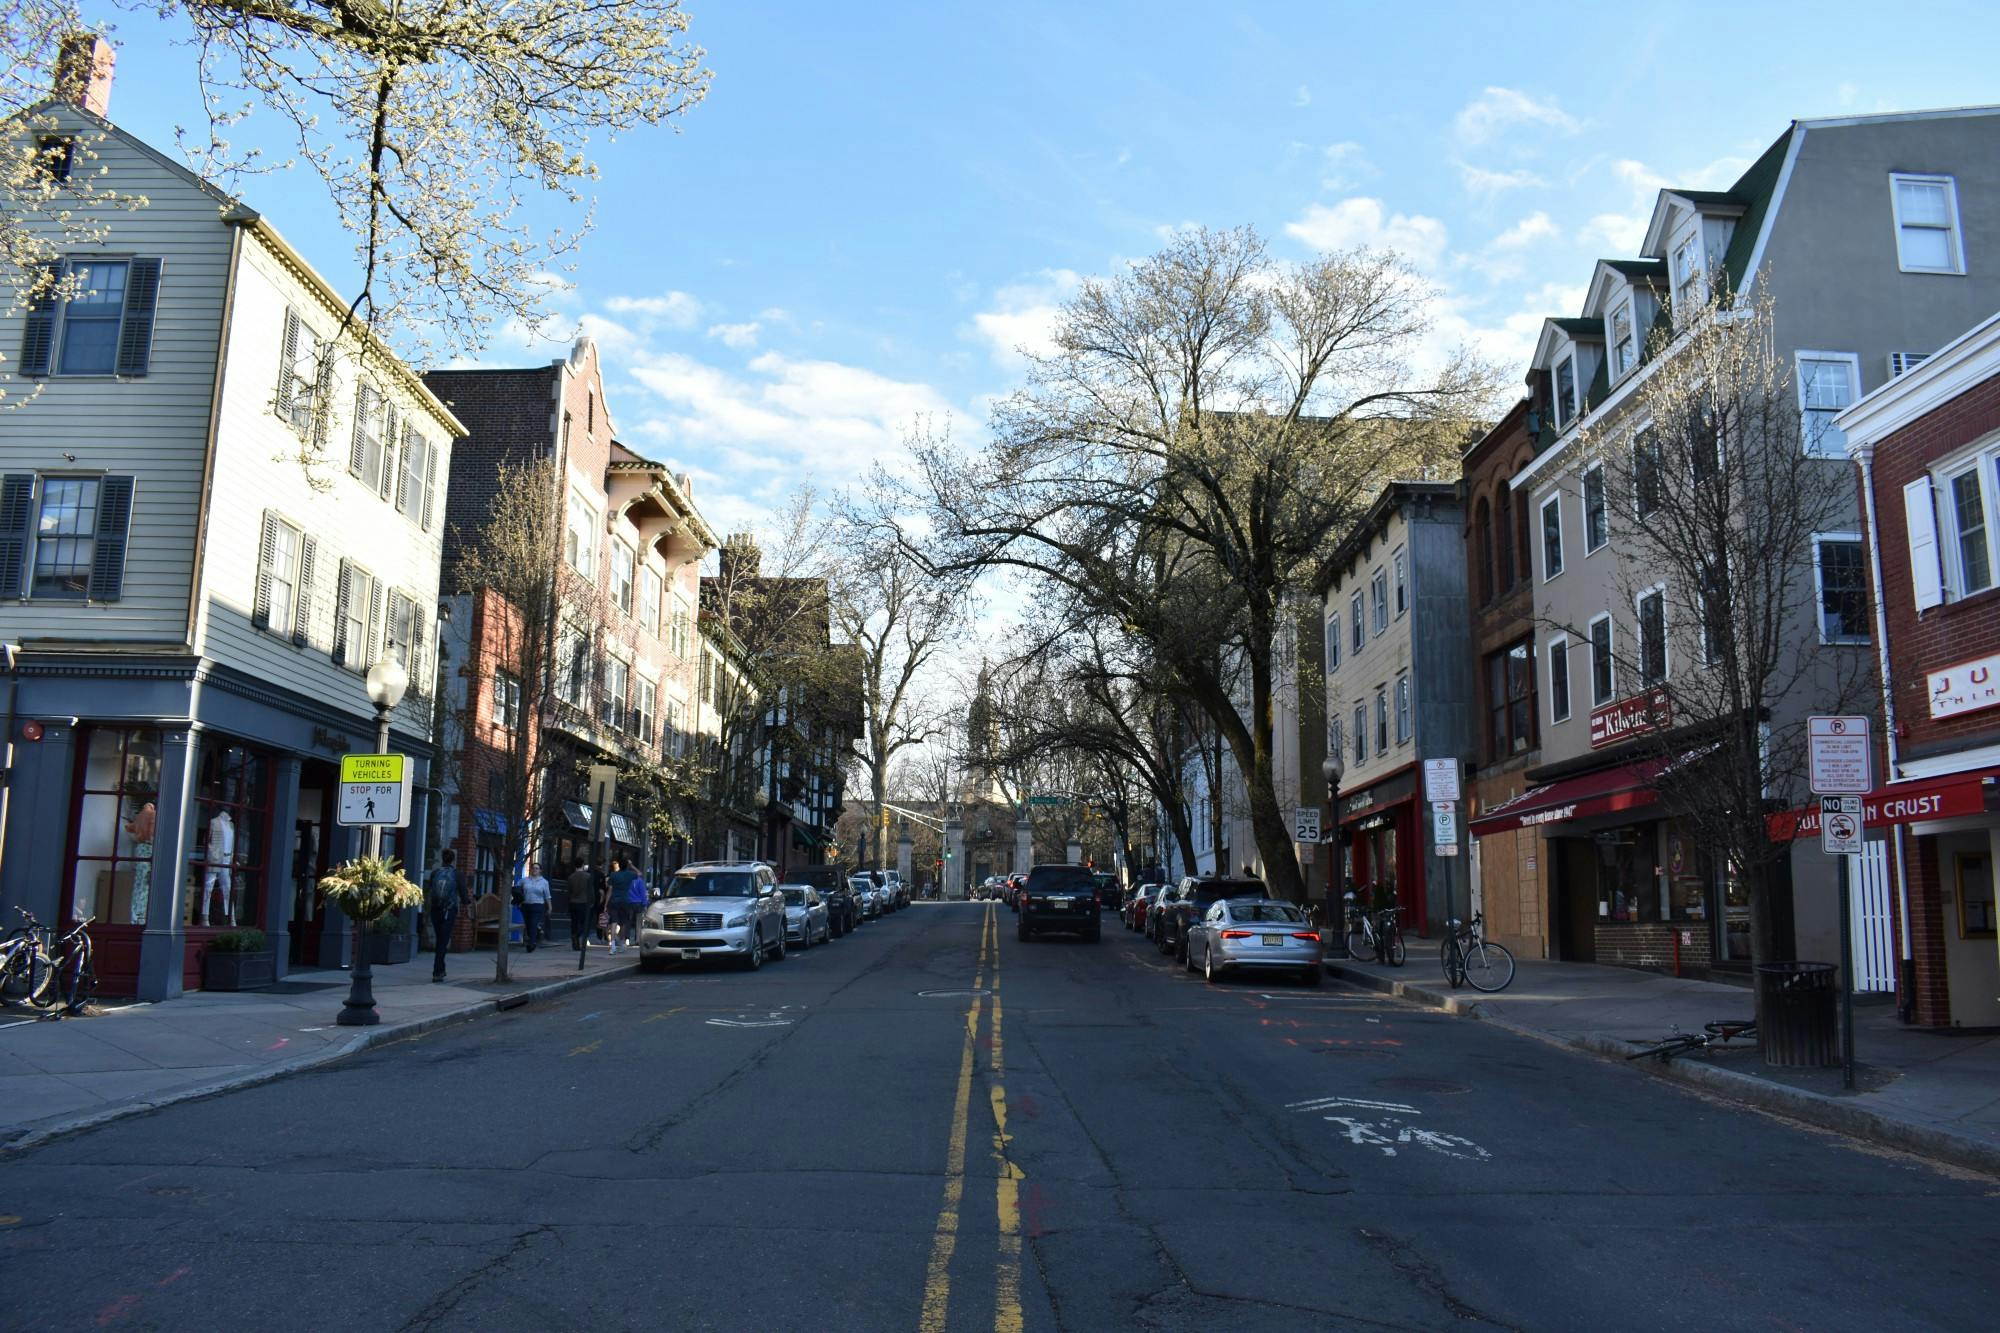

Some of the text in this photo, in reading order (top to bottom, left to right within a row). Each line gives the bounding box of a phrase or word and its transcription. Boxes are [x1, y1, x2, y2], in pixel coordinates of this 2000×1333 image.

[1939, 688, 1995, 708] THIN
[355, 760, 391, 768] TURNING
[353, 770, 392, 779] VEHICLES
[350, 786, 392, 794] STOP FOR
[1824, 799, 1840, 810] NO
[1883, 795, 1941, 818] CRUST
[1297, 826, 1318, 839] 25
